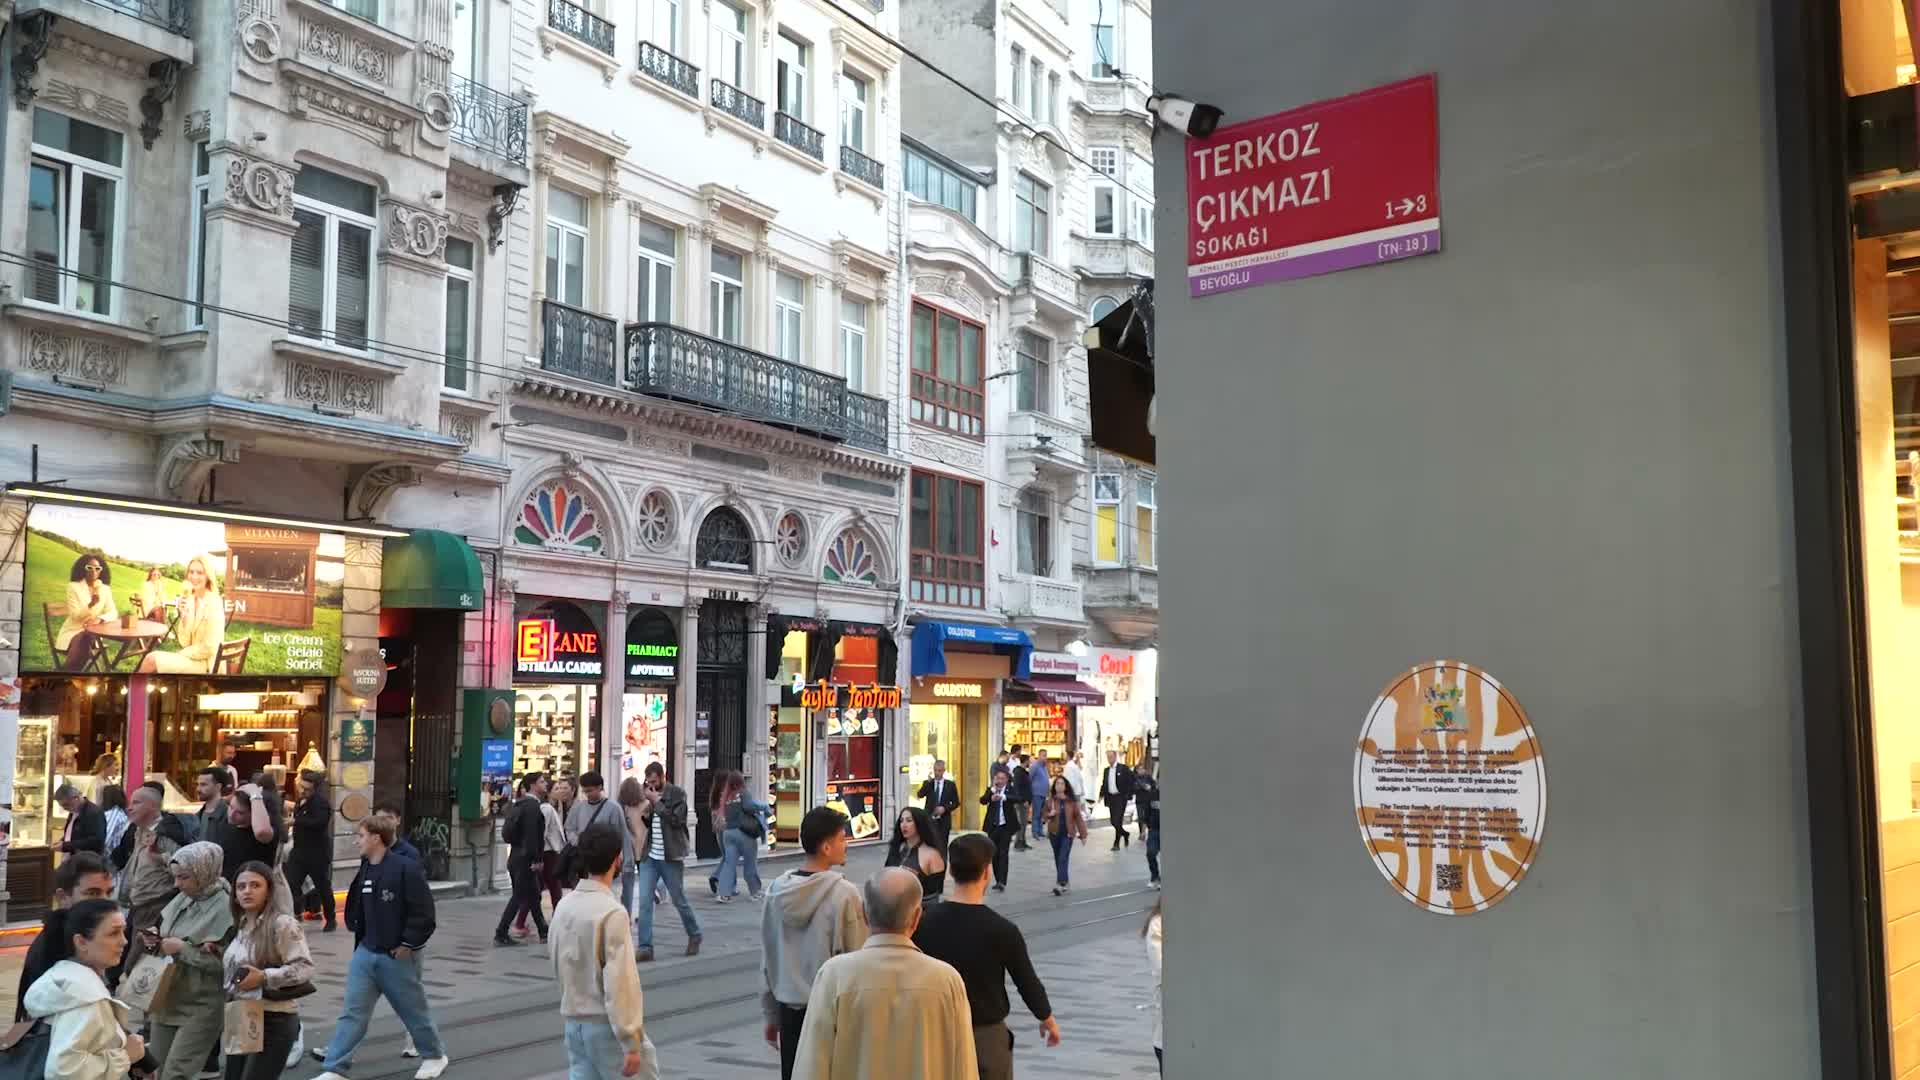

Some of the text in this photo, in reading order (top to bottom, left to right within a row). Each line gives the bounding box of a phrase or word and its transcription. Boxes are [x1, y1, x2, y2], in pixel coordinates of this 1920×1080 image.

[1193, 121, 1321, 181] TERKOZ
[1196, 168, 1332, 233] ÇIKMAZI
[1384, 194, 1427, 220] 1 3
[1195, 226, 1268, 257] SOKAĞI
[1200, 271, 1250, 291] BEYOĞLU
[242, 528, 299, 539] VITAVIEN
[263, 632, 323, 646] Ice Cream
[947, 626, 976, 638] GOLDSTORE
[552, 632, 597, 653] ZANE
[287, 647, 323, 658] Gelato
[627, 644, 678, 657] PHARMACY
[286, 658, 323, 670] Sorbet
[630, 664, 674, 676] APOTHEKE
[801, 679, 902, 713] ayla tantuni
[933, 683, 982, 697] GOLDSTORE
